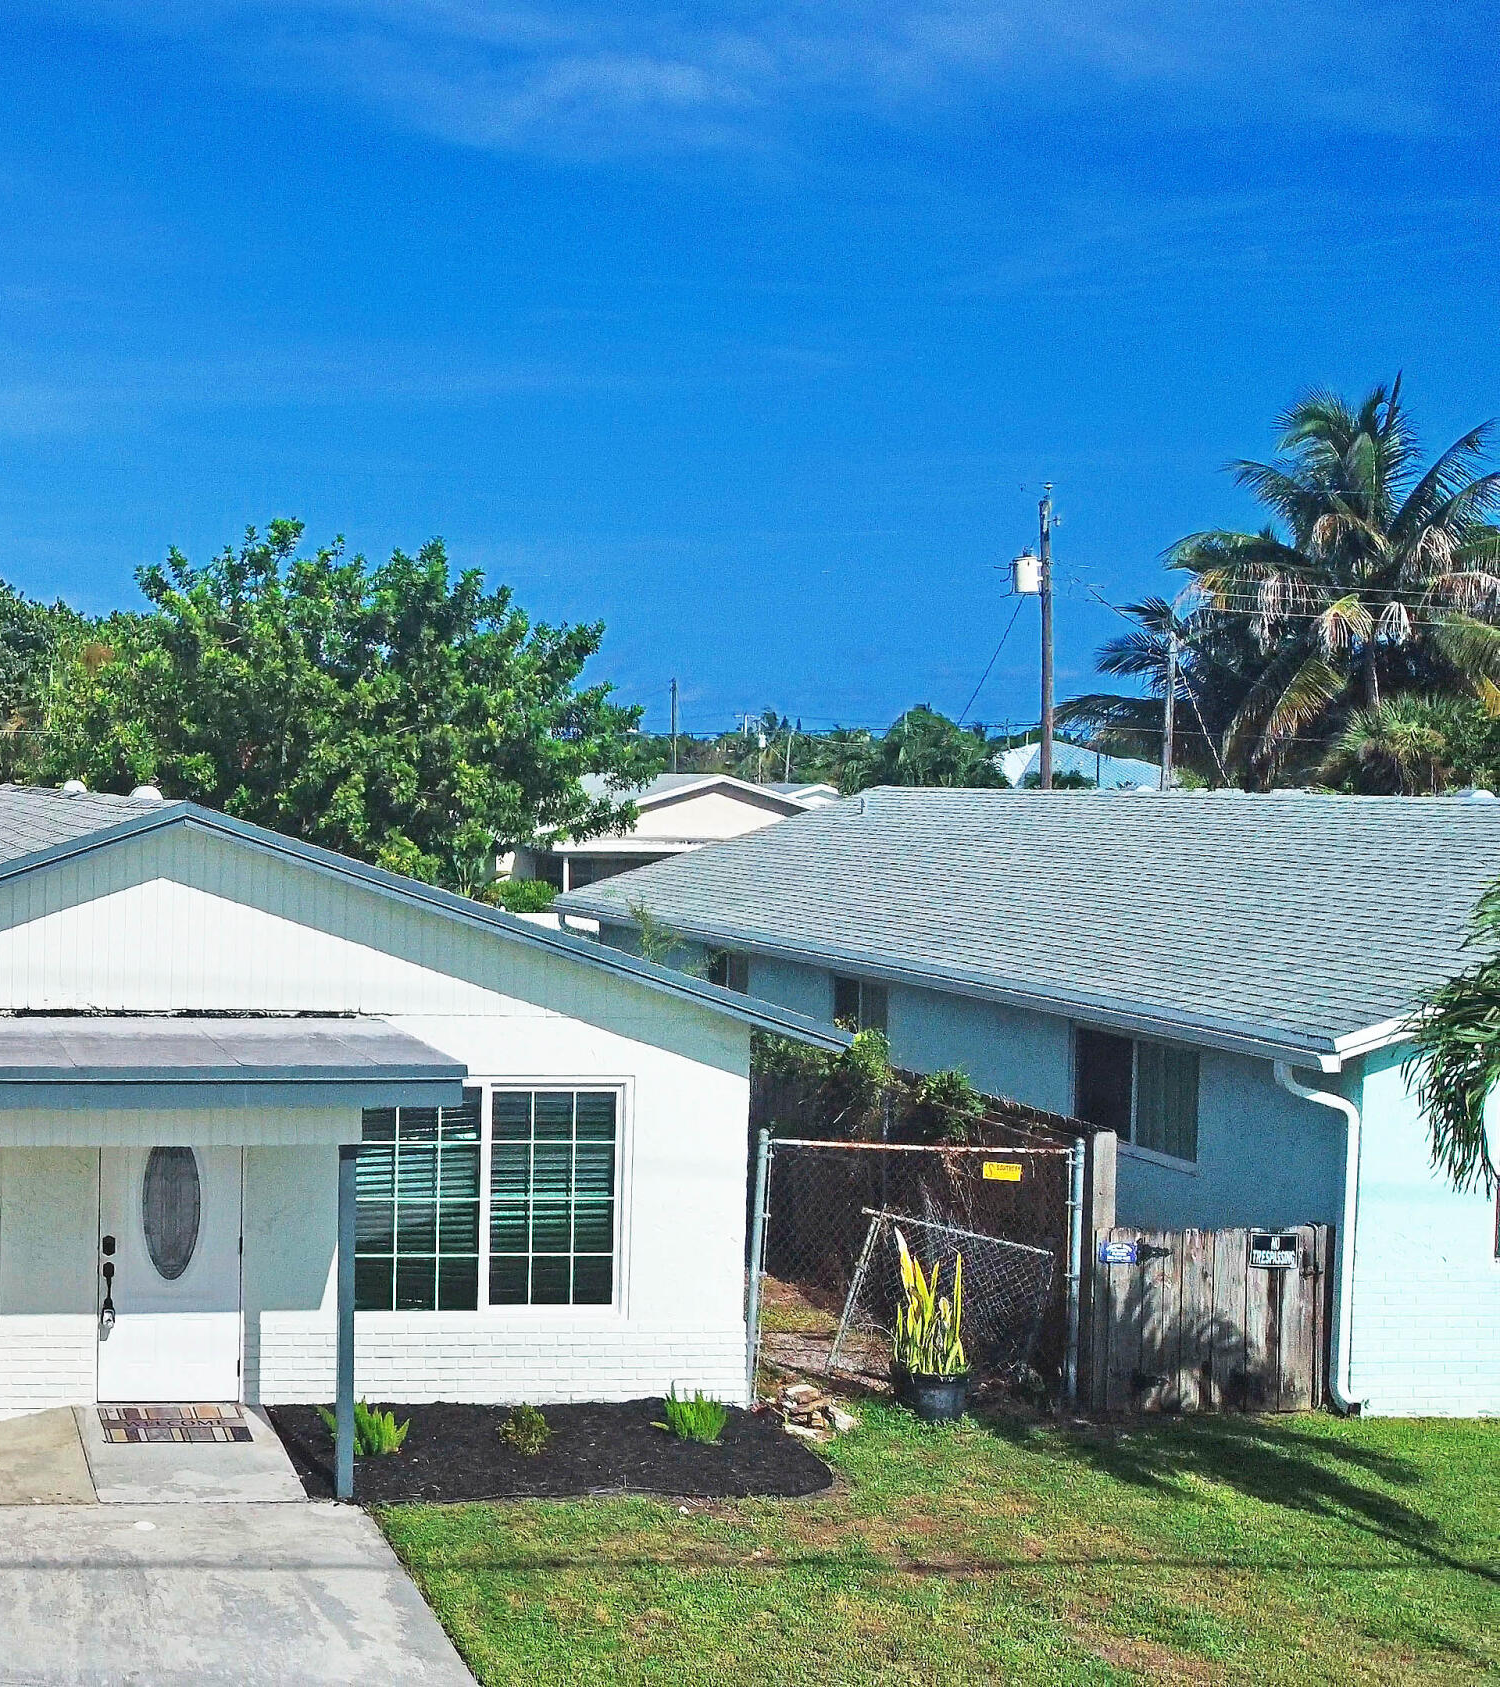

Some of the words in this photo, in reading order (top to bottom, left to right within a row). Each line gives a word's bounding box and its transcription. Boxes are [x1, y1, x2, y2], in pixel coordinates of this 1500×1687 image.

[1270, 1236, 1281, 1251] NO
[1252, 1250, 1296, 1265] TRESPASSING
[124, 1419, 227, 1428] WELCOME
